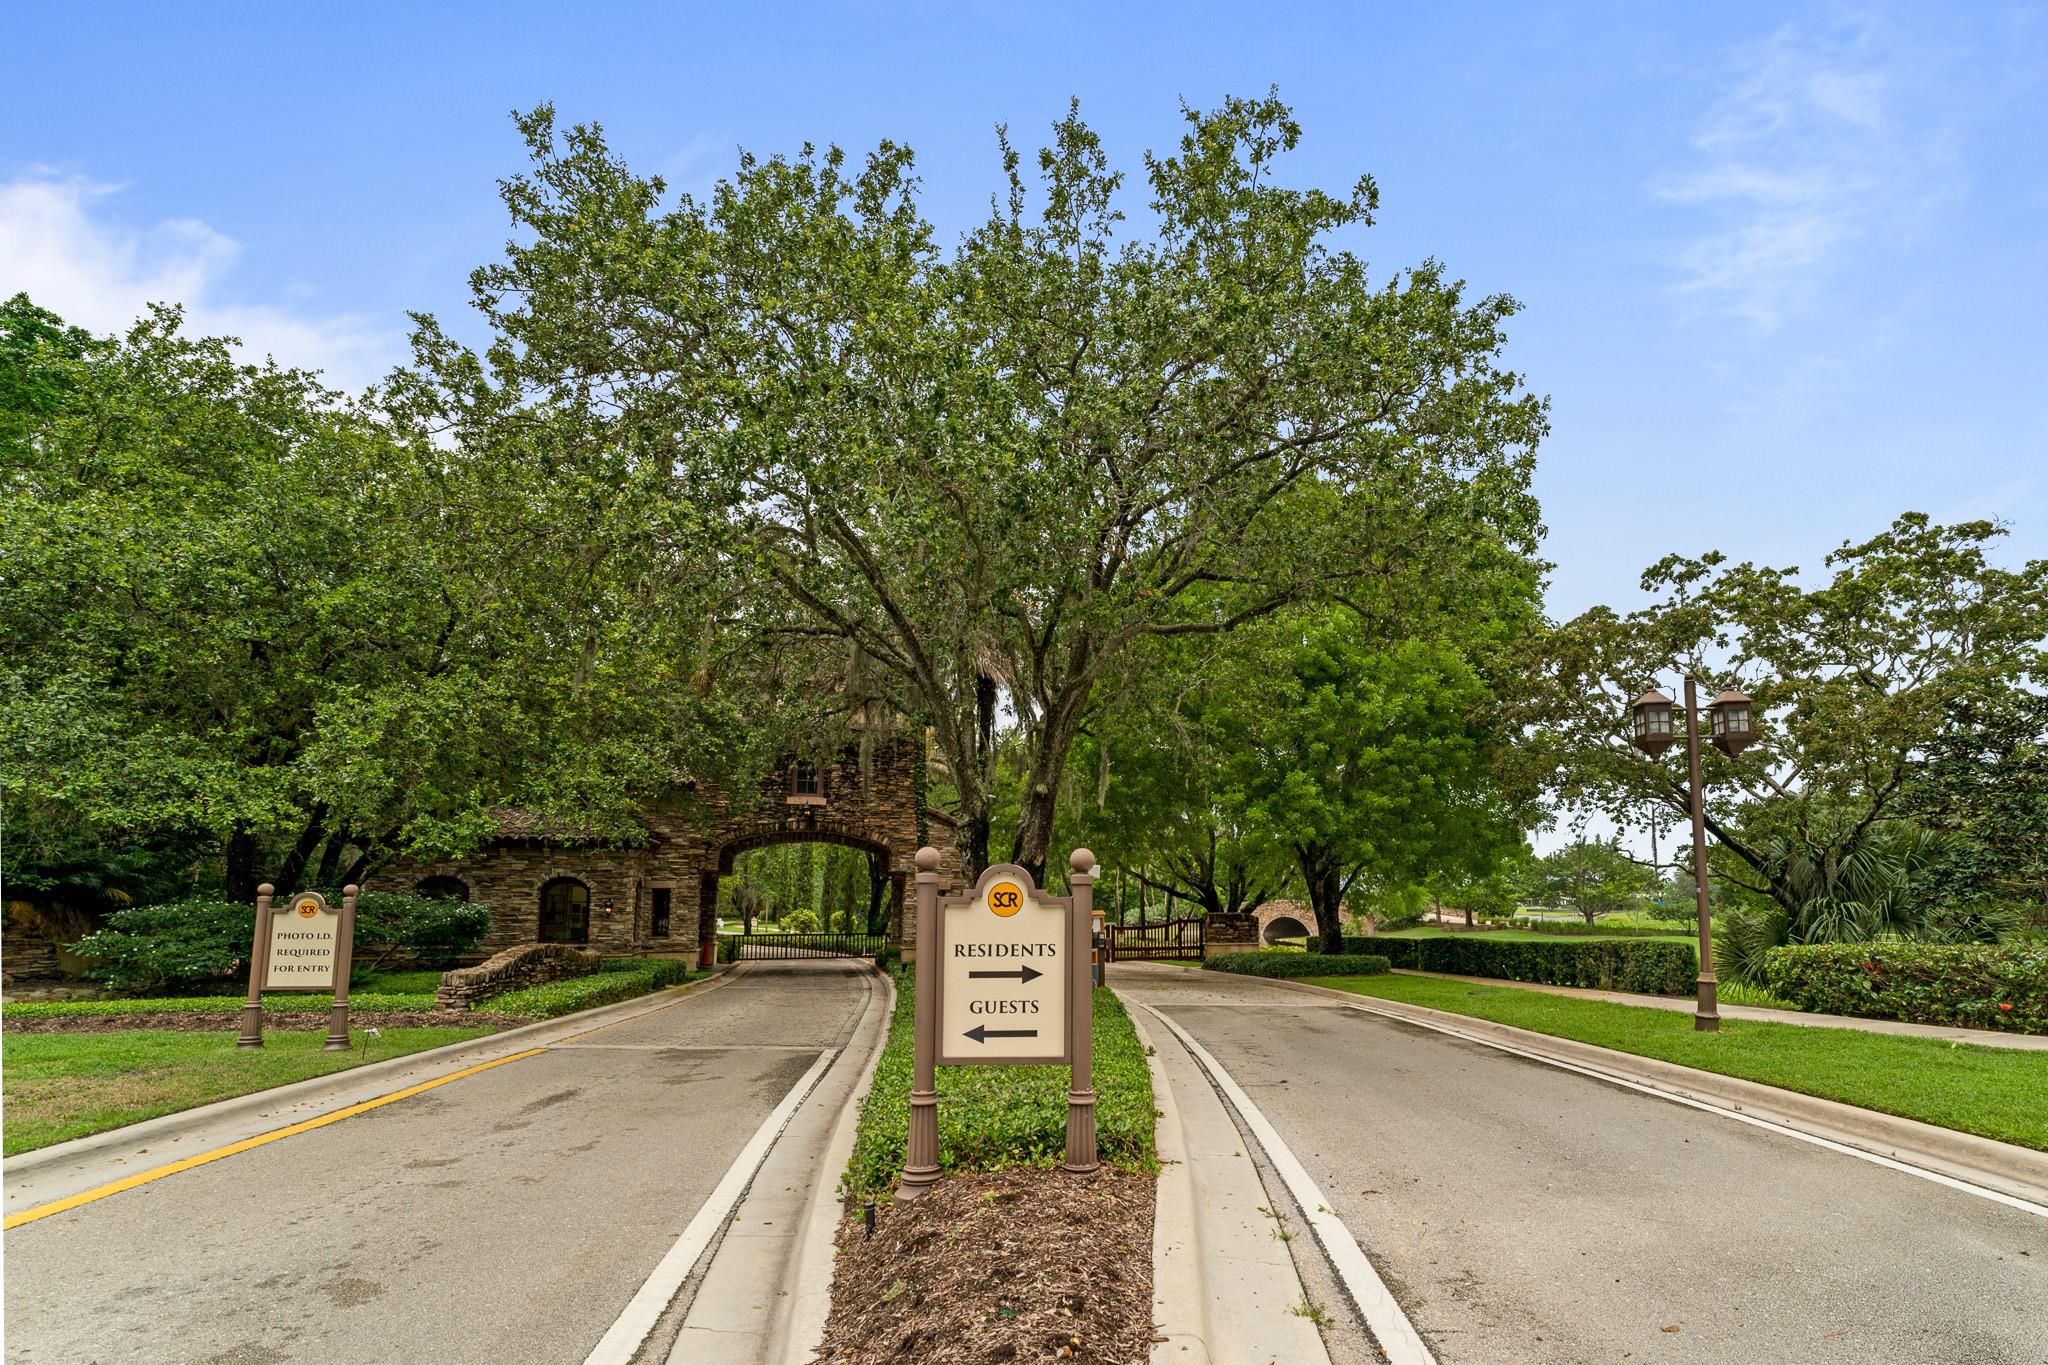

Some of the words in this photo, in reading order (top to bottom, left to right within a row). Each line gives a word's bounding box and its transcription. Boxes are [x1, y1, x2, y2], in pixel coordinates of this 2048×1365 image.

[993, 891, 1018, 908] SCR
[277, 932, 314, 940] PHOTO
[276, 948, 330, 957] REQUIRED
[953, 943, 1056, 957] RESIDENTS
[273, 965, 295, 973] FOR
[297, 965, 330, 973] ENTRY
[969, 1000, 1039, 1014] GUESTS
